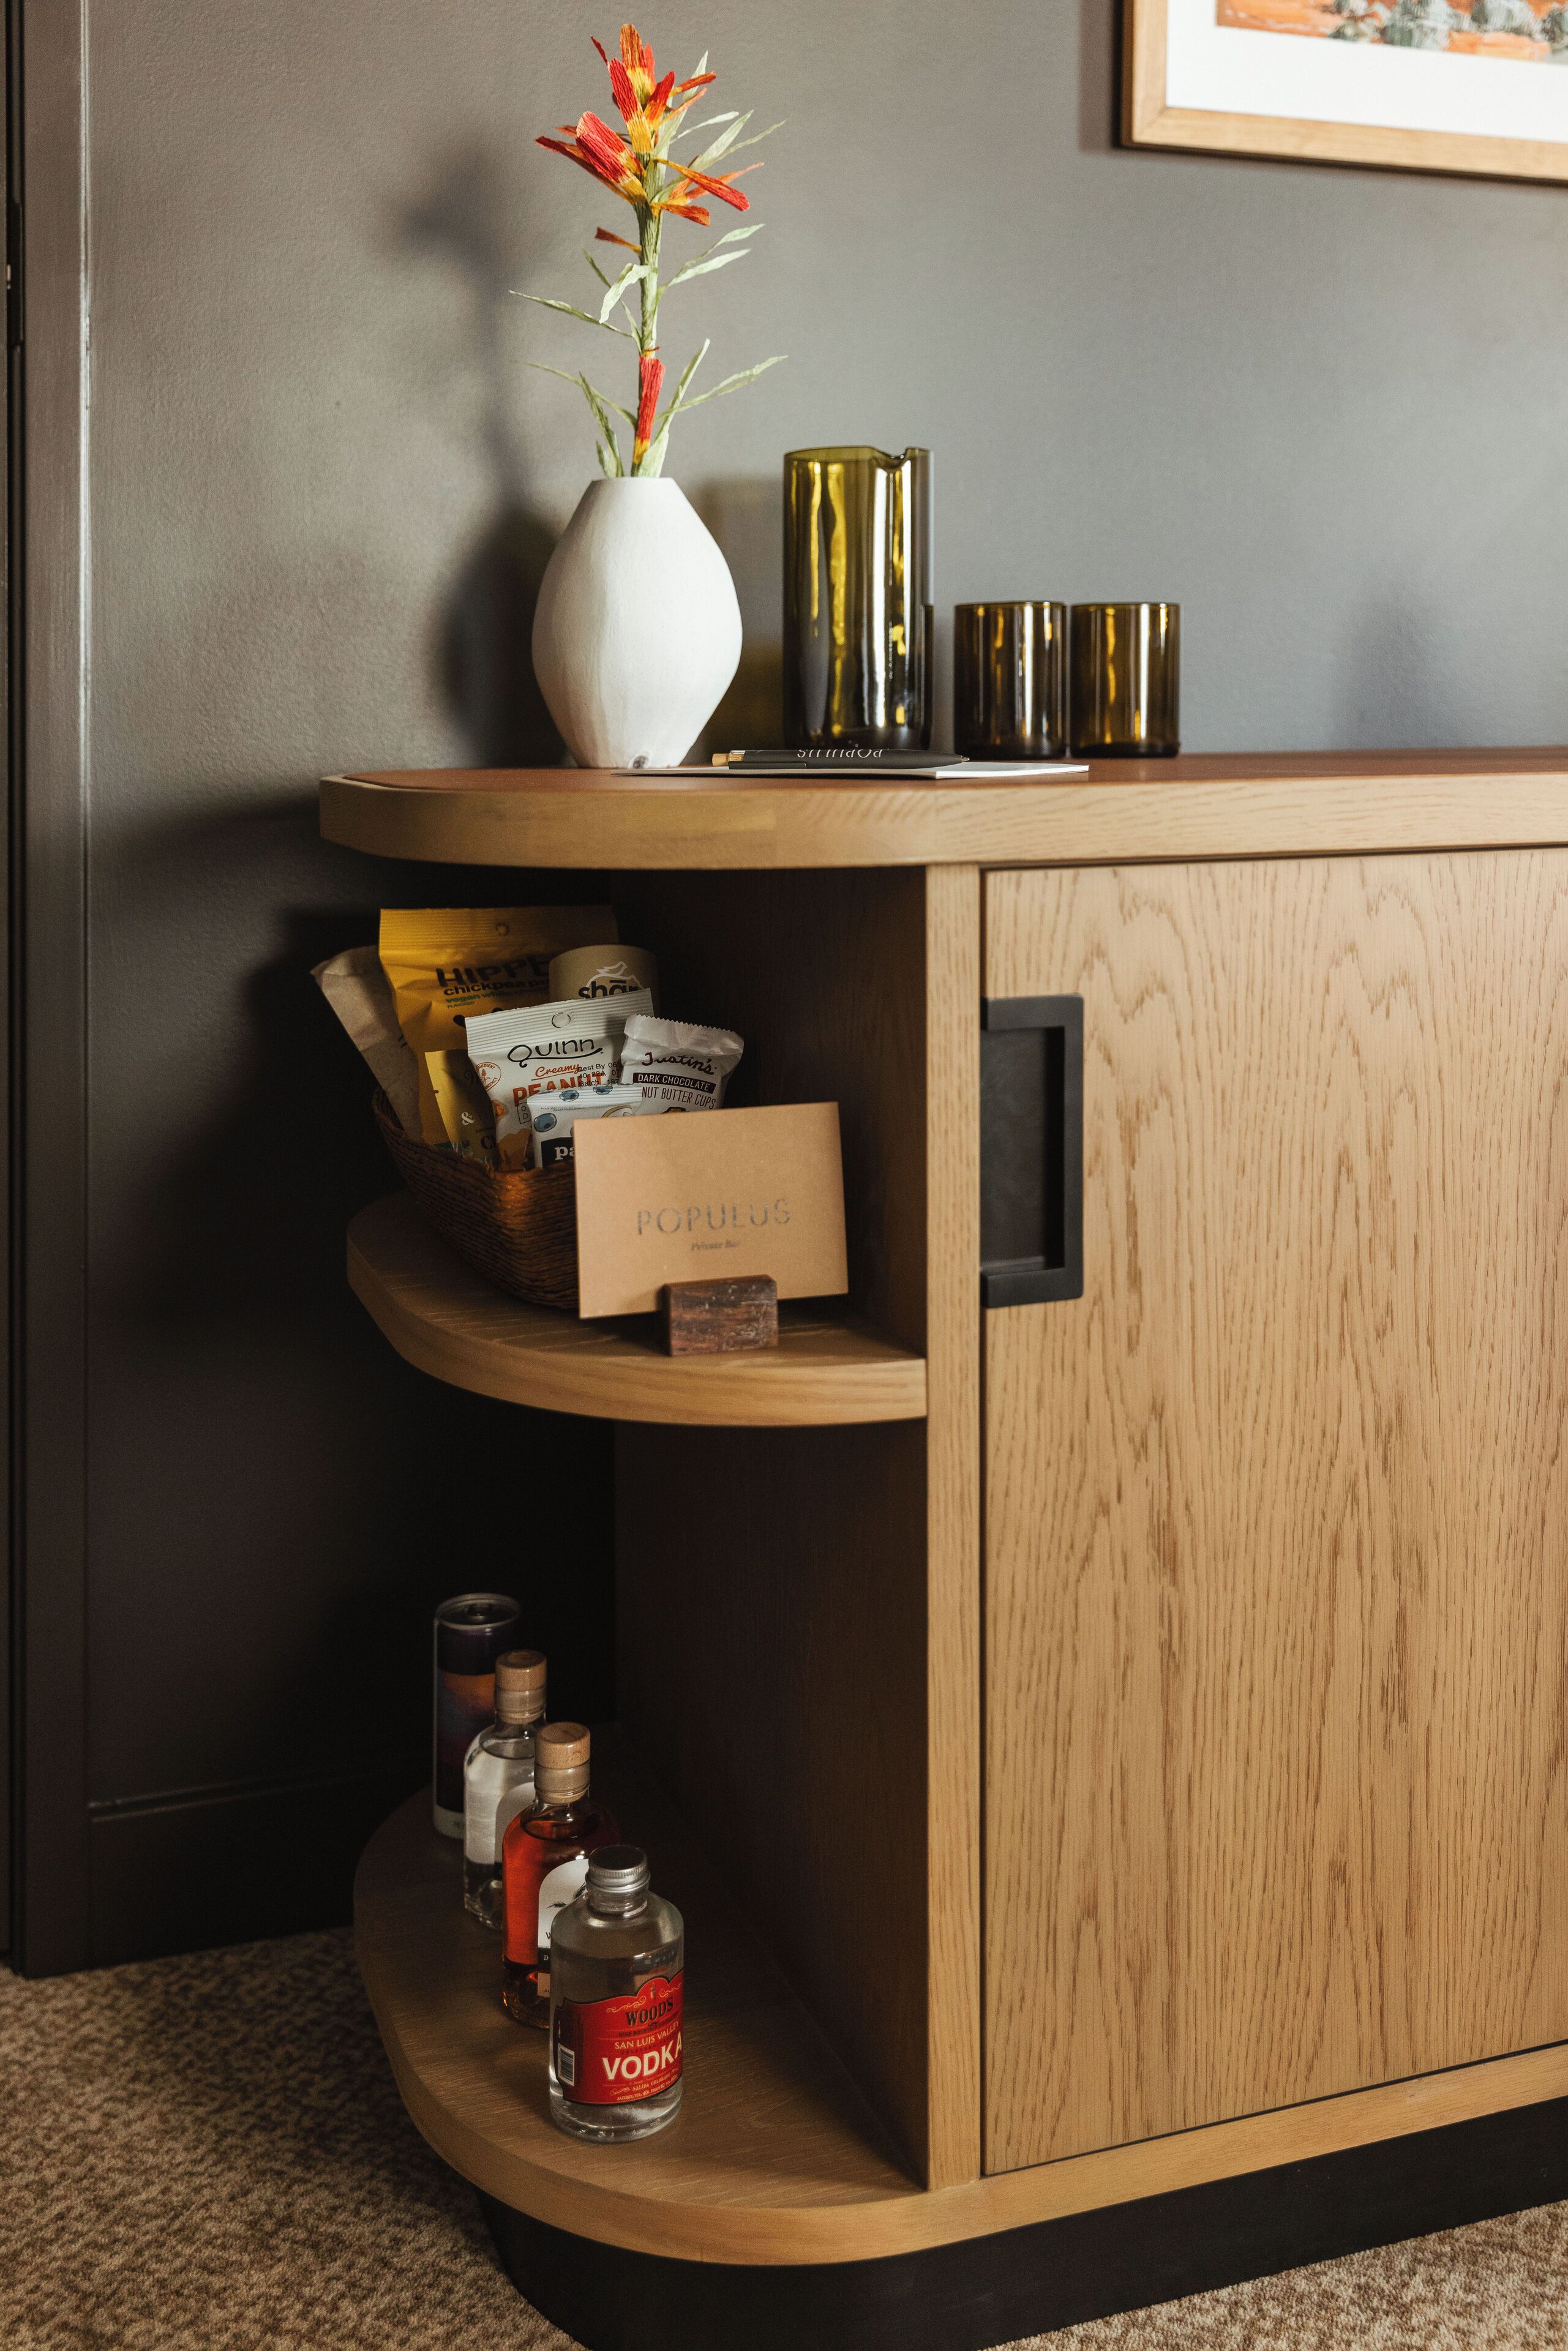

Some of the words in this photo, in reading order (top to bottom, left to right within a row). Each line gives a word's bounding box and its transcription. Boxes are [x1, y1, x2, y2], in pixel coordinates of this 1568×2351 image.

[443, 980, 525, 996] chickpea
[535, 1064, 580, 1077] Creamy
[642, 1052, 715, 1075] Justin's
[638, 1074, 661, 1083] DARK
[662, 1075, 711, 1092] CHOCOLATE
[642, 1086, 659, 1098] NUT
[661, 1087, 693, 1103] BUTTER
[694, 1093, 716, 1109] CUPS
[637, 1198, 791, 1234] POPULUS
[615, 2041, 634, 2050] SAN
[637, 2035, 655, 2047] LUIS
[658, 2021, 678, 2039] VALLEY
[602, 2031, 682, 2080] VODKA
[632, 2082, 650, 2091] SALIDA
